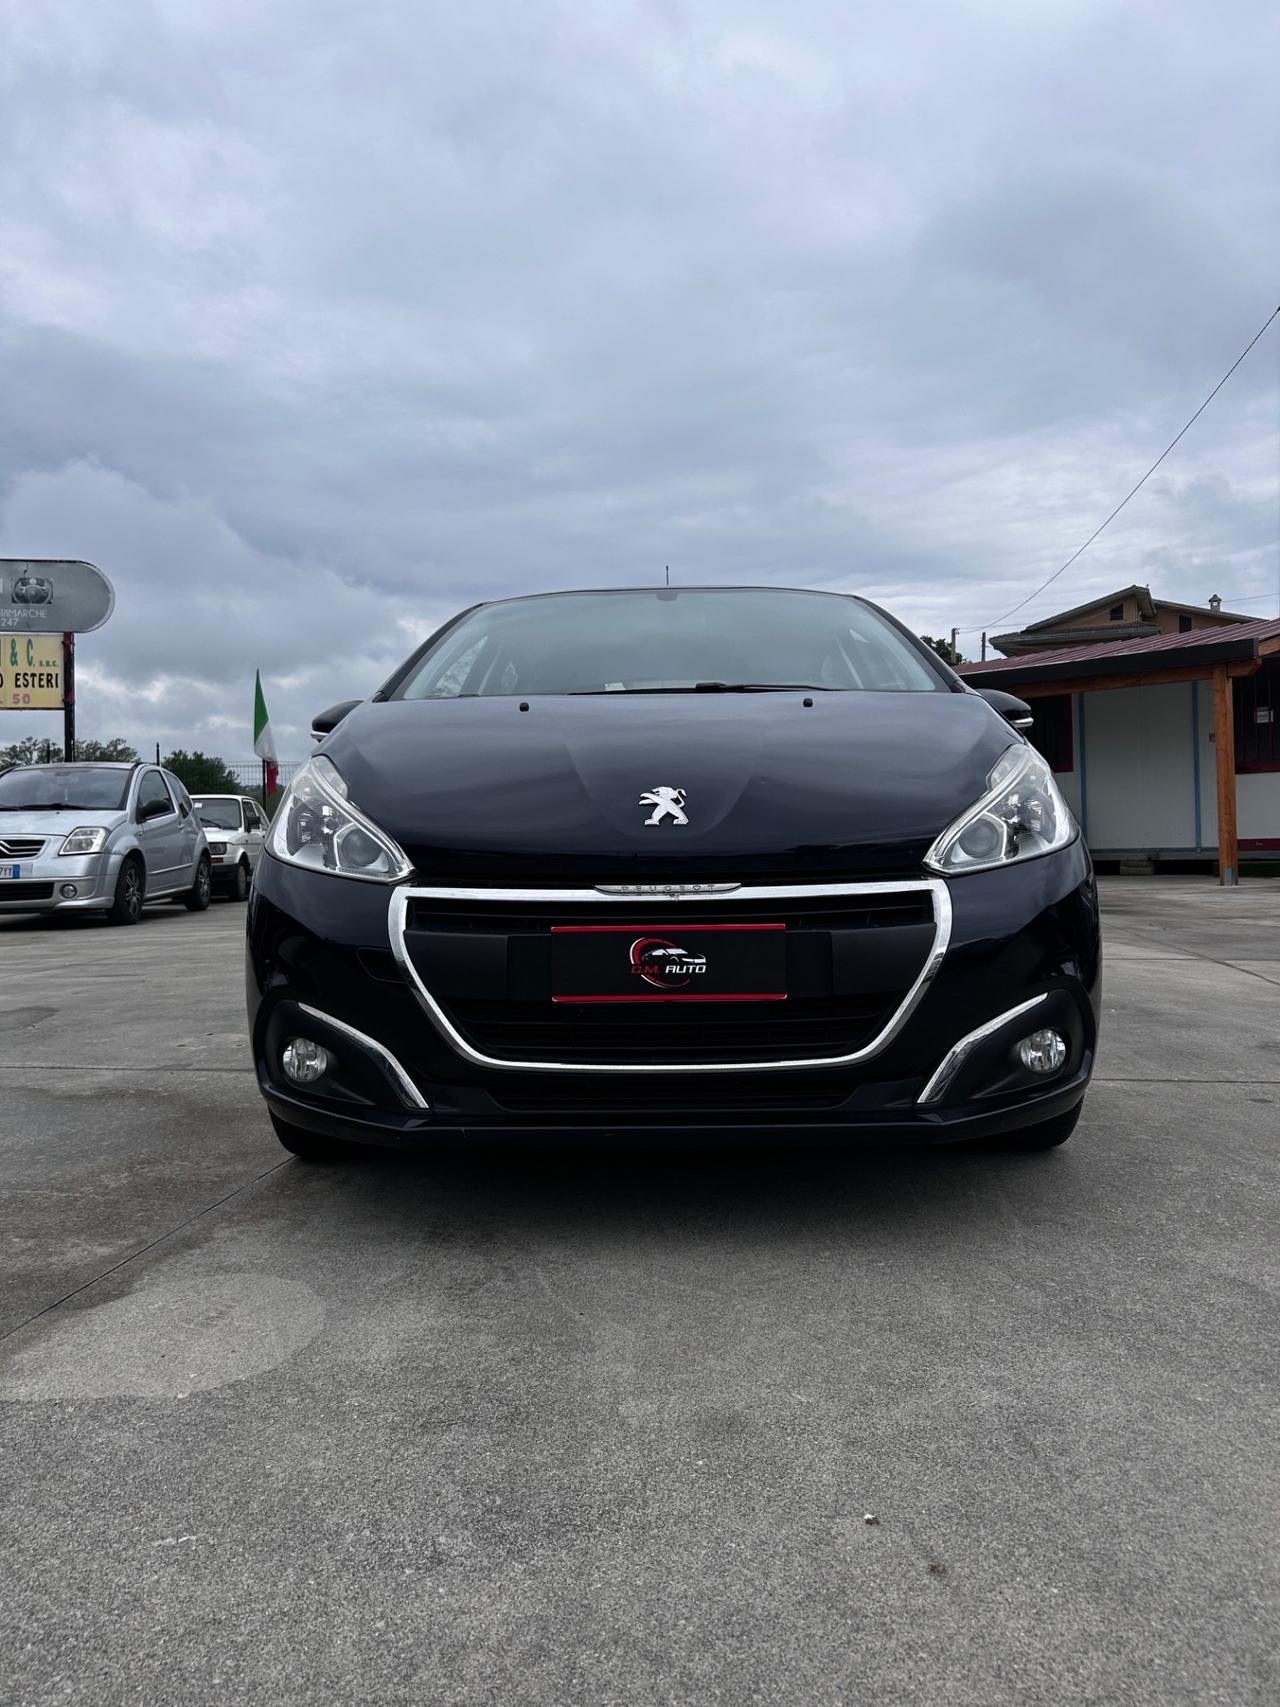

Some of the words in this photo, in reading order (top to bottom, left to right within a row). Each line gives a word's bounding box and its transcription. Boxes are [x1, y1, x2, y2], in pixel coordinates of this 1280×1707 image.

[10, 638, 19, 667] &
[15, 672, 59, 689] ESTERI
[12, 693, 31, 705] 50
[620, 884, 716, 893] PEUGEOT
[665, 965, 706, 974] AUTO
